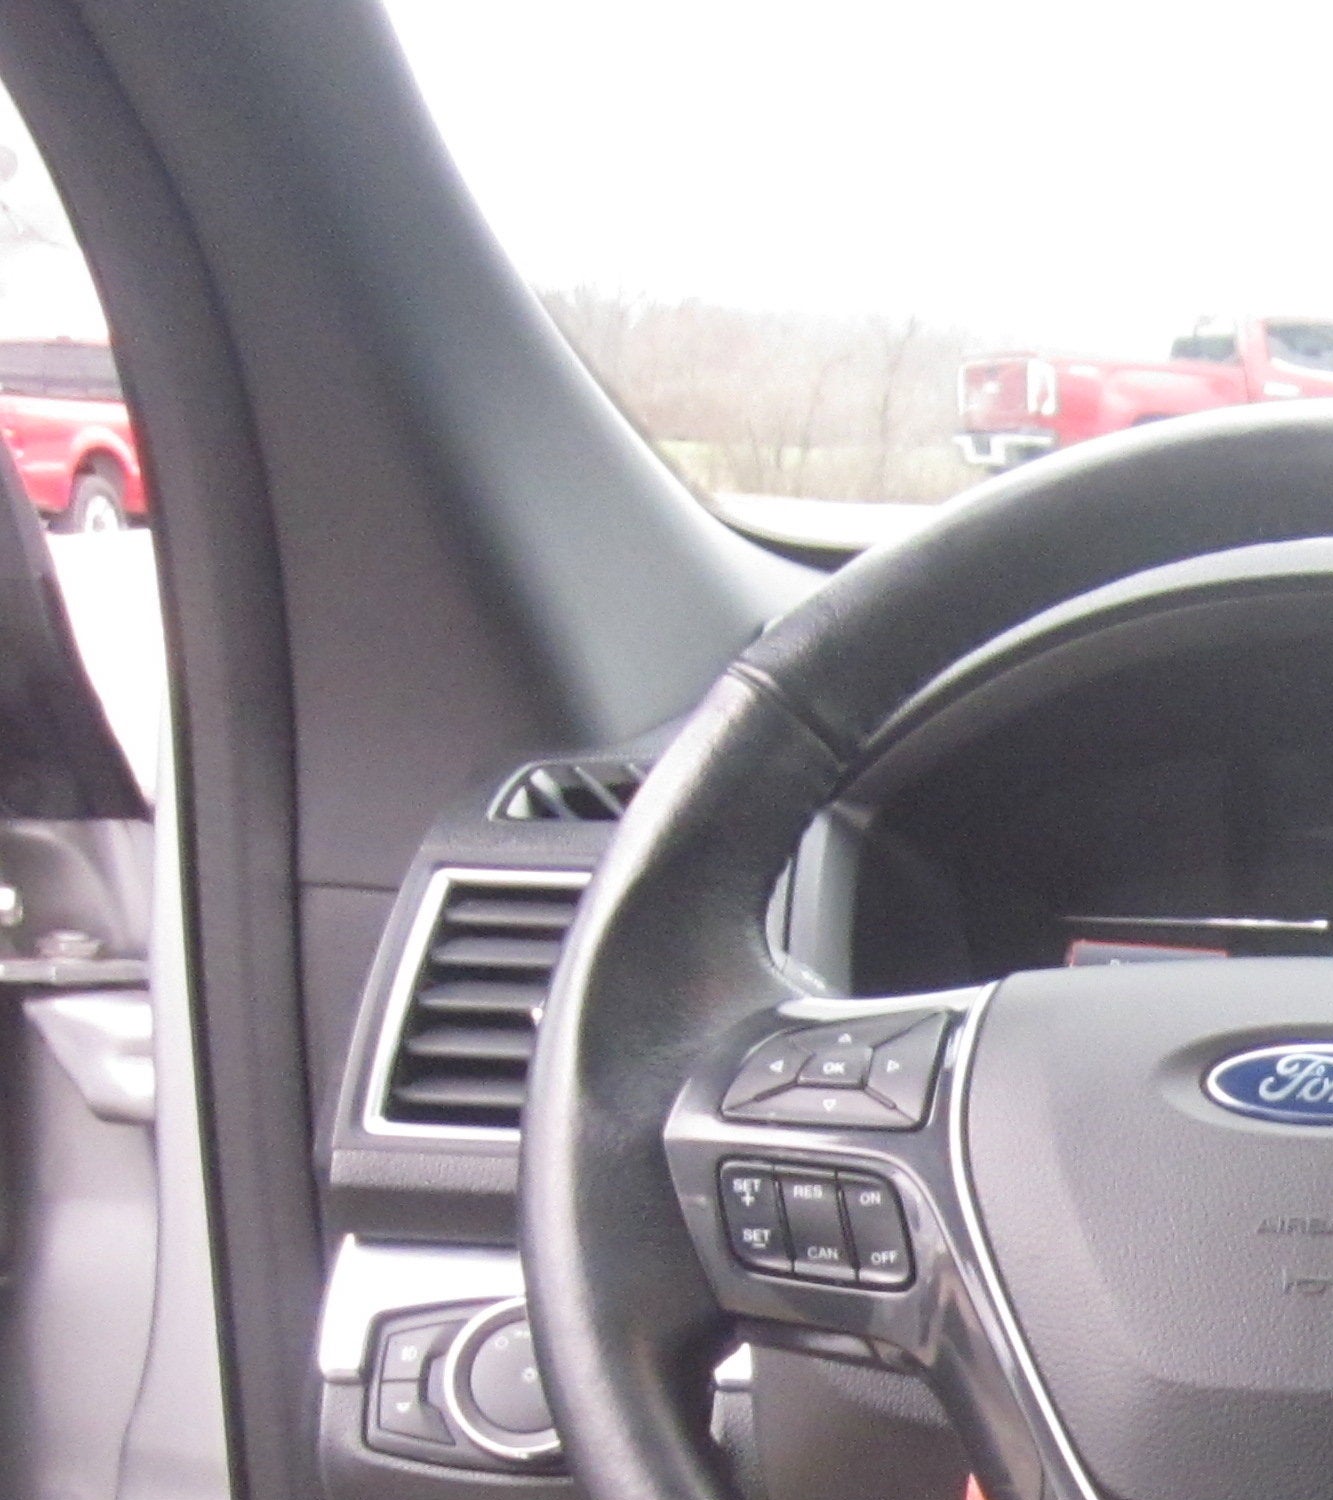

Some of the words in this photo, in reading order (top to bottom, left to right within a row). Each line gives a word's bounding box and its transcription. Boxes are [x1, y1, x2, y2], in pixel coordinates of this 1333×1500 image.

[822, 1060, 846, 1075] OK
[732, 1178, 762, 1192] SET
[793, 1184, 824, 1199] RES
[860, 1191, 882, 1206] ON
[742, 1228, 772, 1244] SET
[807, 1245, 839, 1261] CAN
[870, 1250, 899, 1265] OFF
